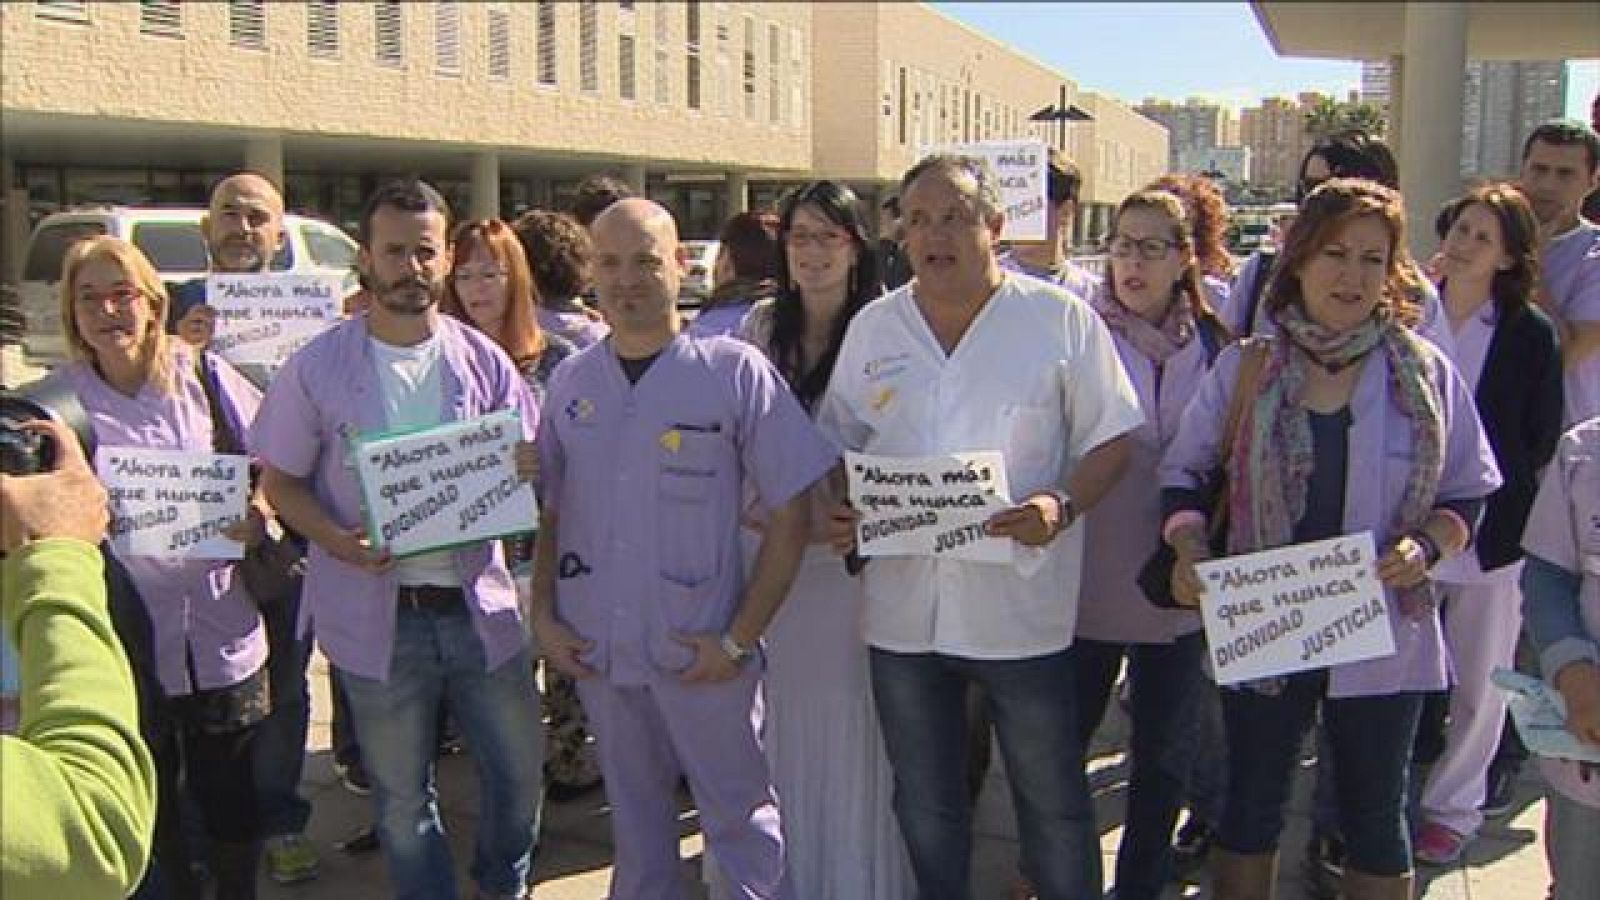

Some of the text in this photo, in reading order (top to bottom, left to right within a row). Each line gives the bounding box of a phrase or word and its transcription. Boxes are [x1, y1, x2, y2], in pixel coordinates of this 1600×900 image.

[292, 280, 330, 298] más
[110, 456, 235, 480] "Ahora más
[370, 421, 503, 471] "Ahora más
[155, 486, 237, 503] nunca"
[380, 444, 508, 505] que nunca"
[854, 459, 991, 486] "Ahora más
[381, 484, 459, 541] DIGNIDAD
[459, 474, 524, 531] JUSTICI
[860, 487, 996, 511] que nunca"
[862, 510, 938, 543] DIGNIDAD
[1208, 543, 1361, 591] "Ahora más
[1217, 569, 1366, 627] que nunca"
[1215, 608, 1304, 668] DIGNIDAD
[1300, 598, 1385, 661] JUSTICIA
